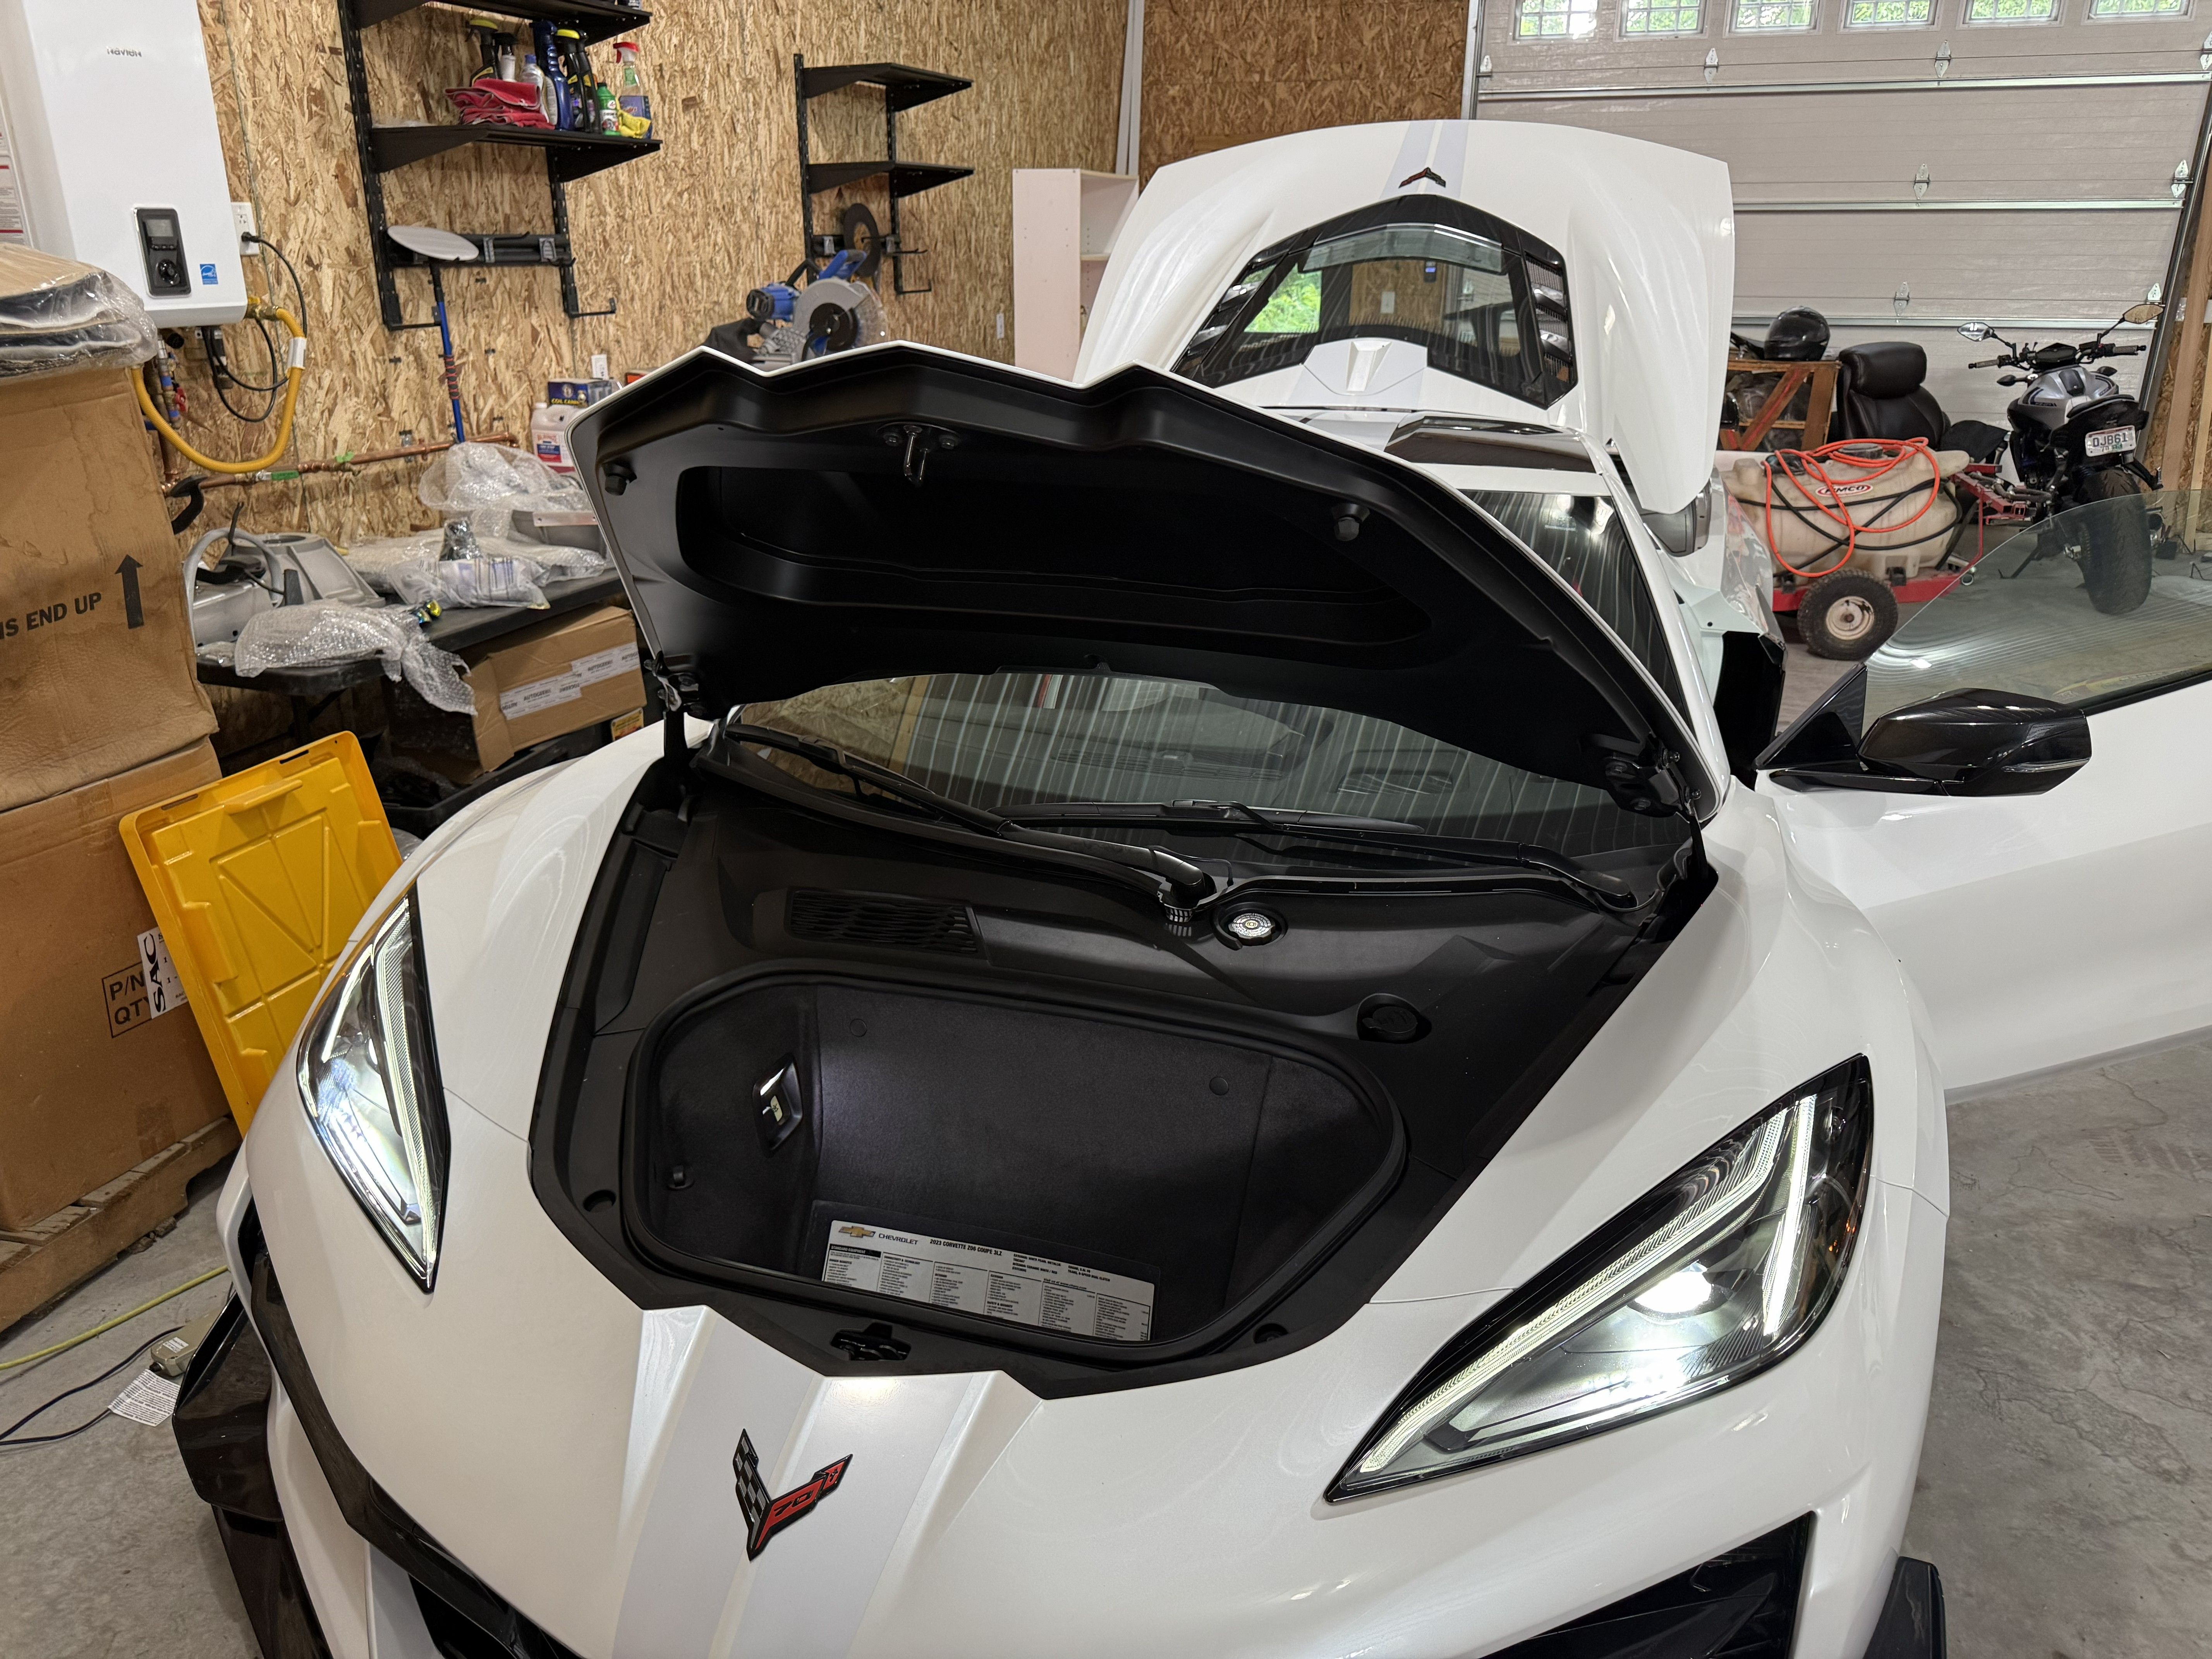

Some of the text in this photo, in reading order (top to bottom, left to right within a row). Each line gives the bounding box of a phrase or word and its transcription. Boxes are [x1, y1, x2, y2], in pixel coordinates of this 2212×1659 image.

[26, 603, 67, 631] END
[74, 592, 101, 615] UP
[144, 933, 167, 1013] SAC
[879, 1233, 919, 1245] CHEVROLET
[943, 1241, 966, 1250] CORVETTE
